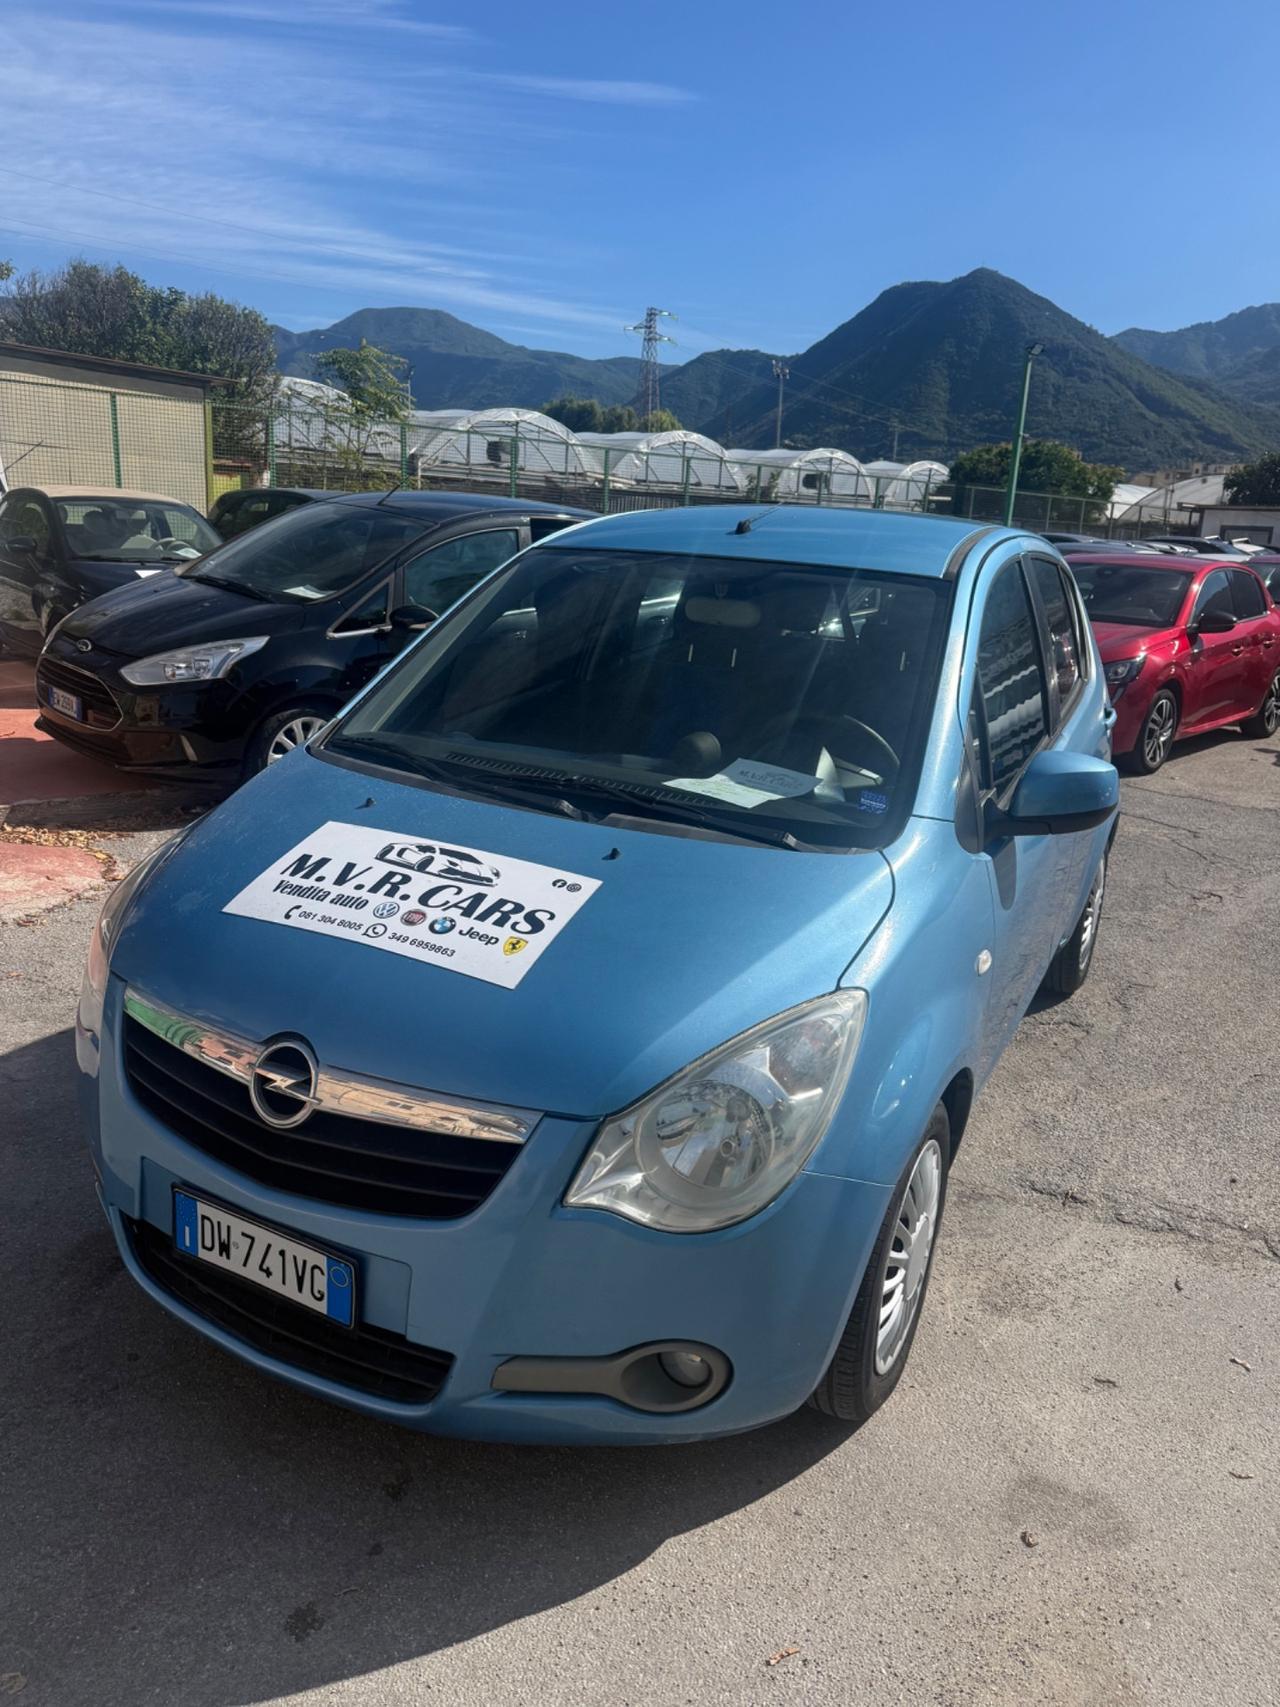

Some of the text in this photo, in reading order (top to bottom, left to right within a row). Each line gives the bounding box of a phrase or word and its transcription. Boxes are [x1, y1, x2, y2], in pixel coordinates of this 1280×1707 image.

[272, 880, 369, 910] Vendita auto
[298, 910, 364, 931] 081 304 8005
[387, 932, 457, 957] 349 6959863
[459, 926, 499, 946] Jeep
